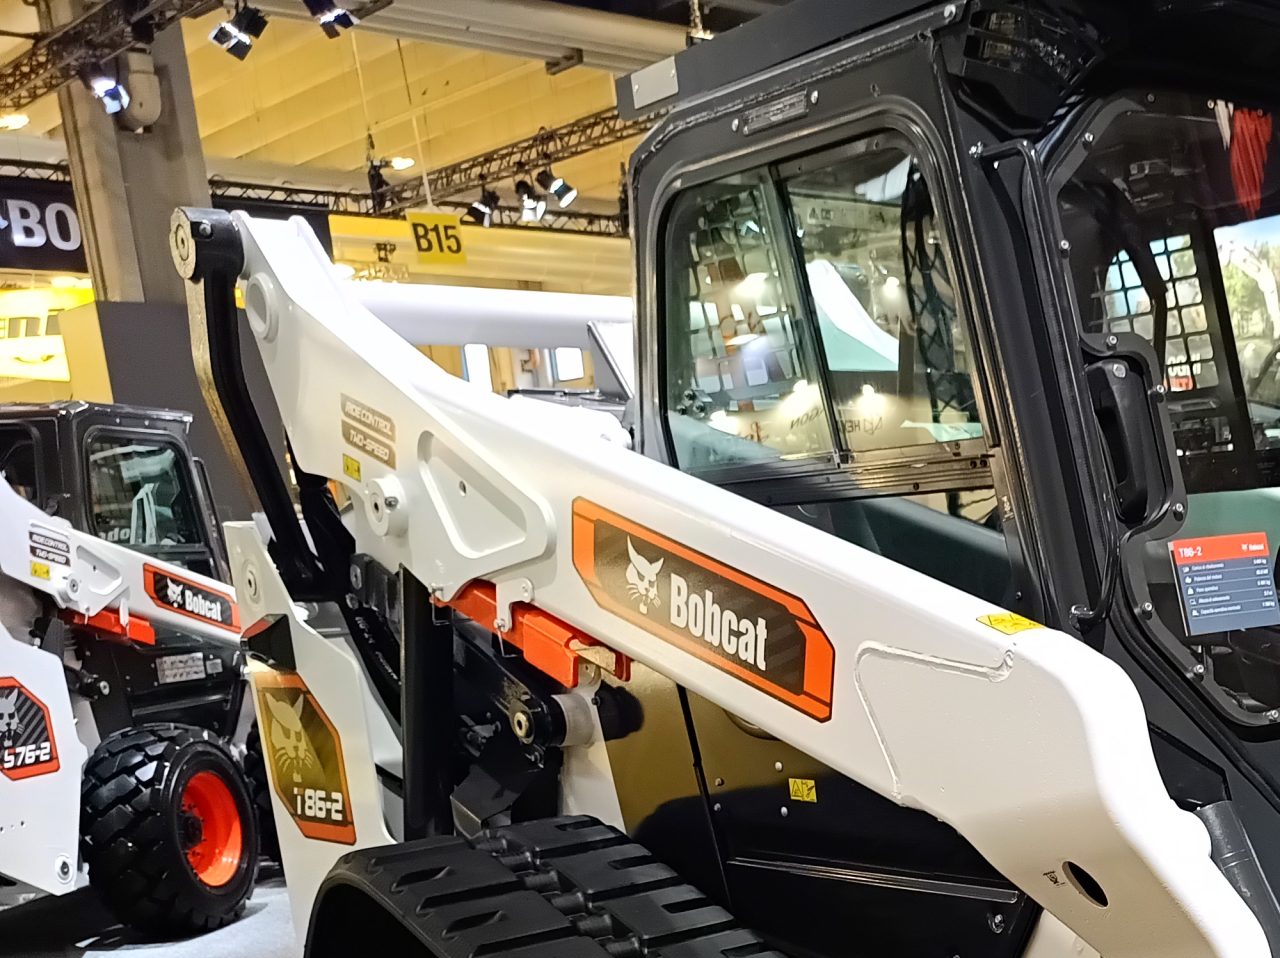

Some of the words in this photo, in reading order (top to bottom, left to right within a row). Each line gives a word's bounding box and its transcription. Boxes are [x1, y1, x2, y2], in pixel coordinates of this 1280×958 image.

[7, 199, 81, 251] BO
[412, 222, 462, 254] B15
[361, 409, 393, 436] CONTROL
[184, 589, 222, 622] Bobcat
[670, 573, 767, 671] Bobcat
[3, 741, 51, 769] S76-2
